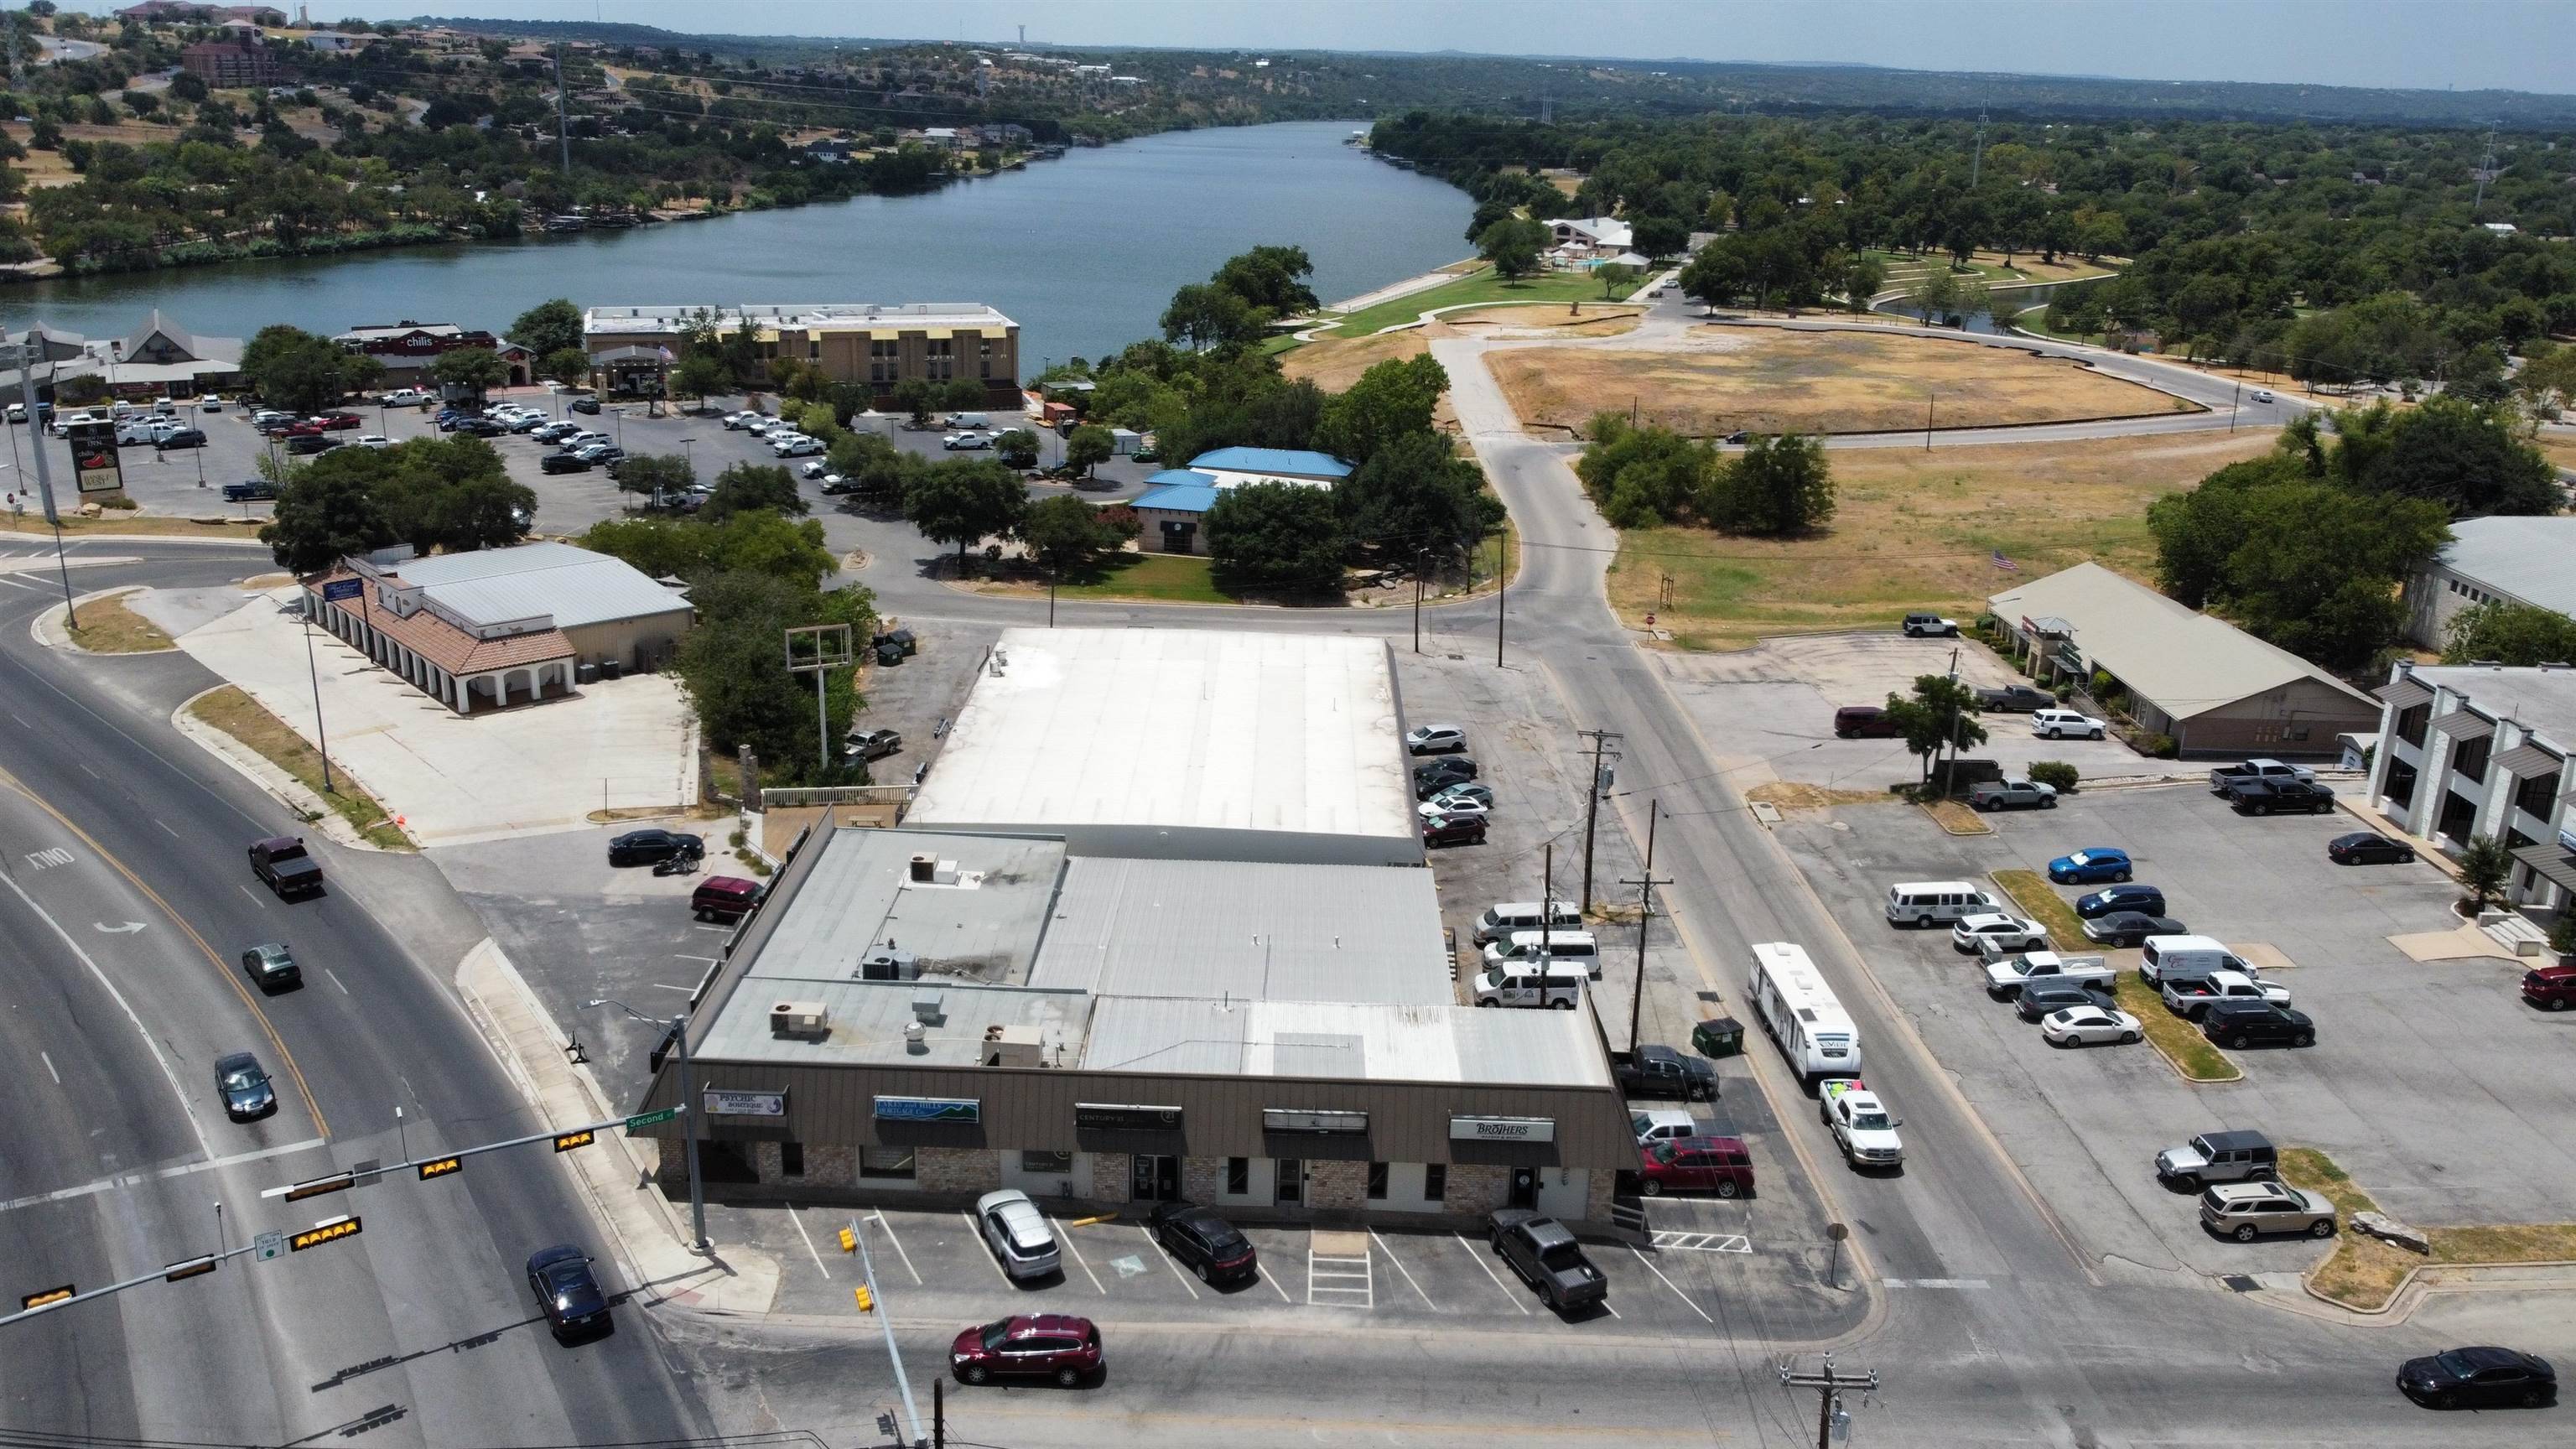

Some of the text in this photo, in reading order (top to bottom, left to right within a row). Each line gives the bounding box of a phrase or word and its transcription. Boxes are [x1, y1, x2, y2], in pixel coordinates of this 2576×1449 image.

[24, 847, 75, 870] ONLY
[719, 1093, 756, 1102] PSYCHIC
[630, 1113, 663, 1127] Second
